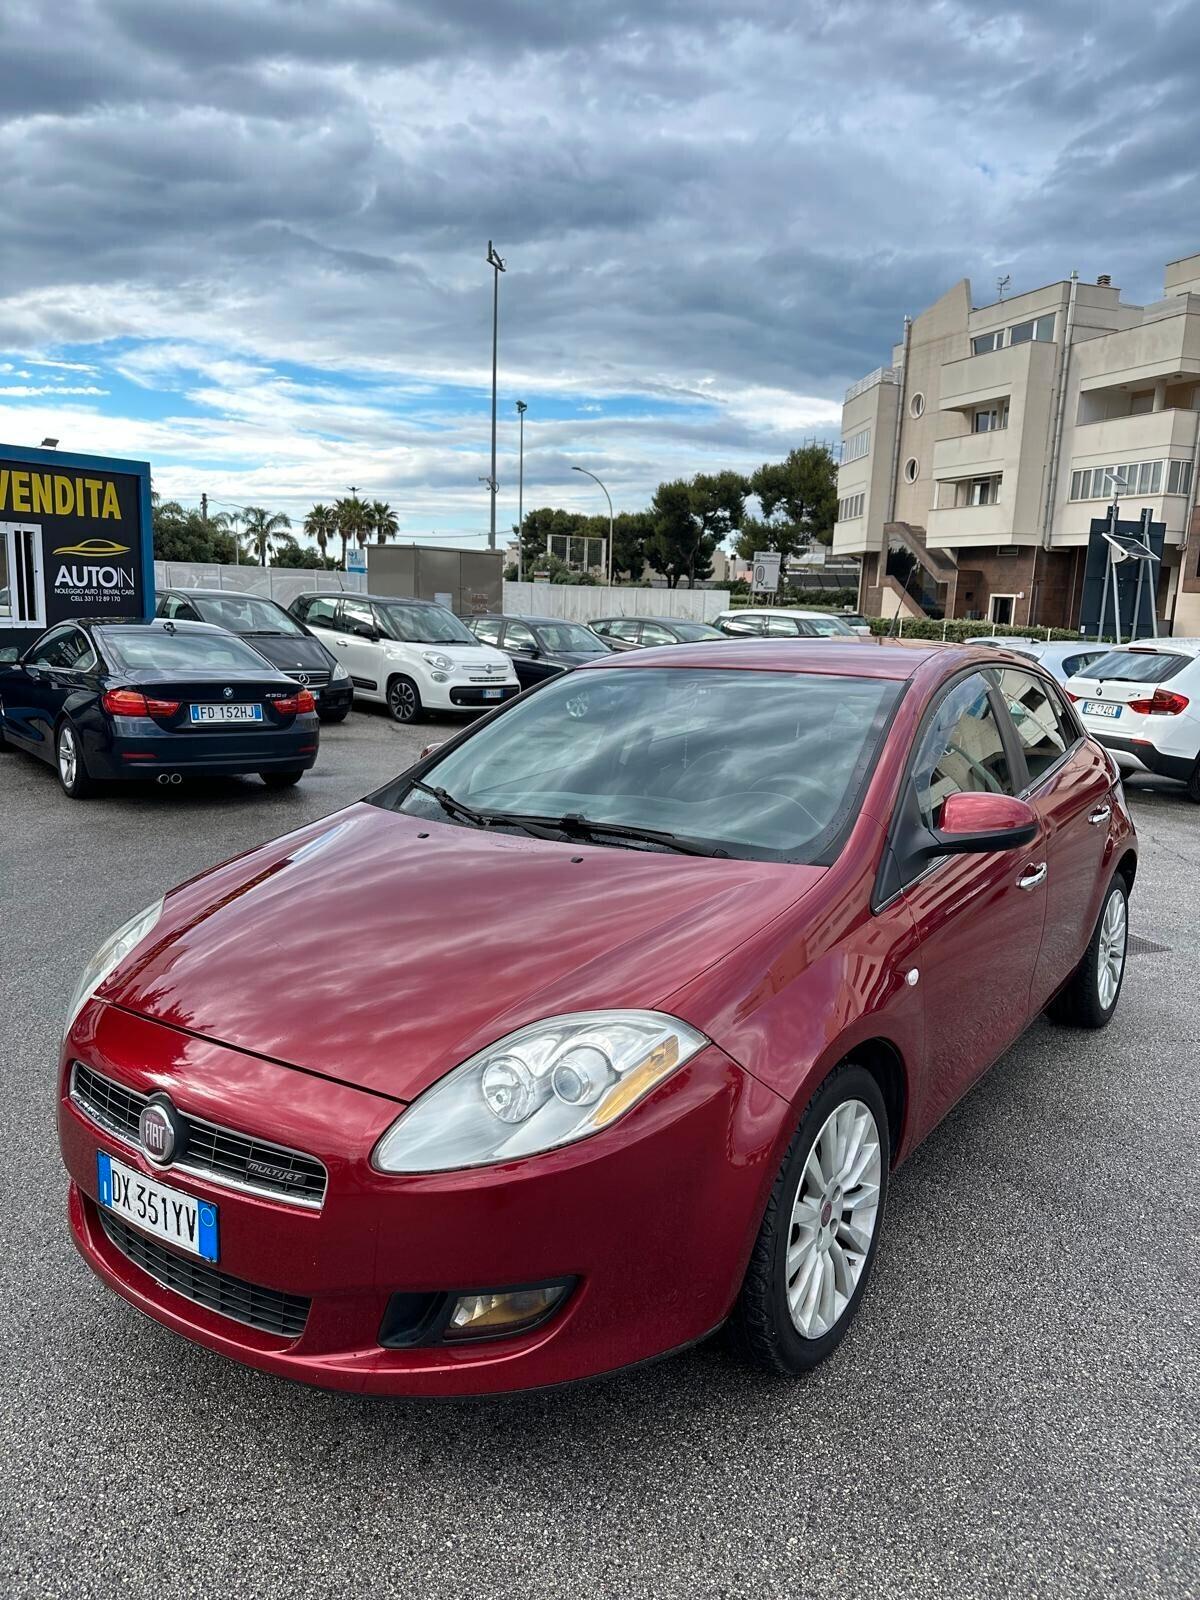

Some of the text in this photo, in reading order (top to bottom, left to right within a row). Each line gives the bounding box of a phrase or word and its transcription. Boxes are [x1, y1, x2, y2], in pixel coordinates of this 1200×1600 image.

[0, 470, 122, 520] VENDITA
[54, 587, 84, 595] NOLEGGIO
[102, 588, 121, 596] RENTAL
[200, 706, 215, 719] FD
[219, 706, 254, 719] 152HJ
[145, 1119, 165, 1150] FIAT
[247, 1162, 302, 1181] MULTIJET
[111, 1169, 131, 1211] DX
[136, 1182, 197, 1243] 351YV
